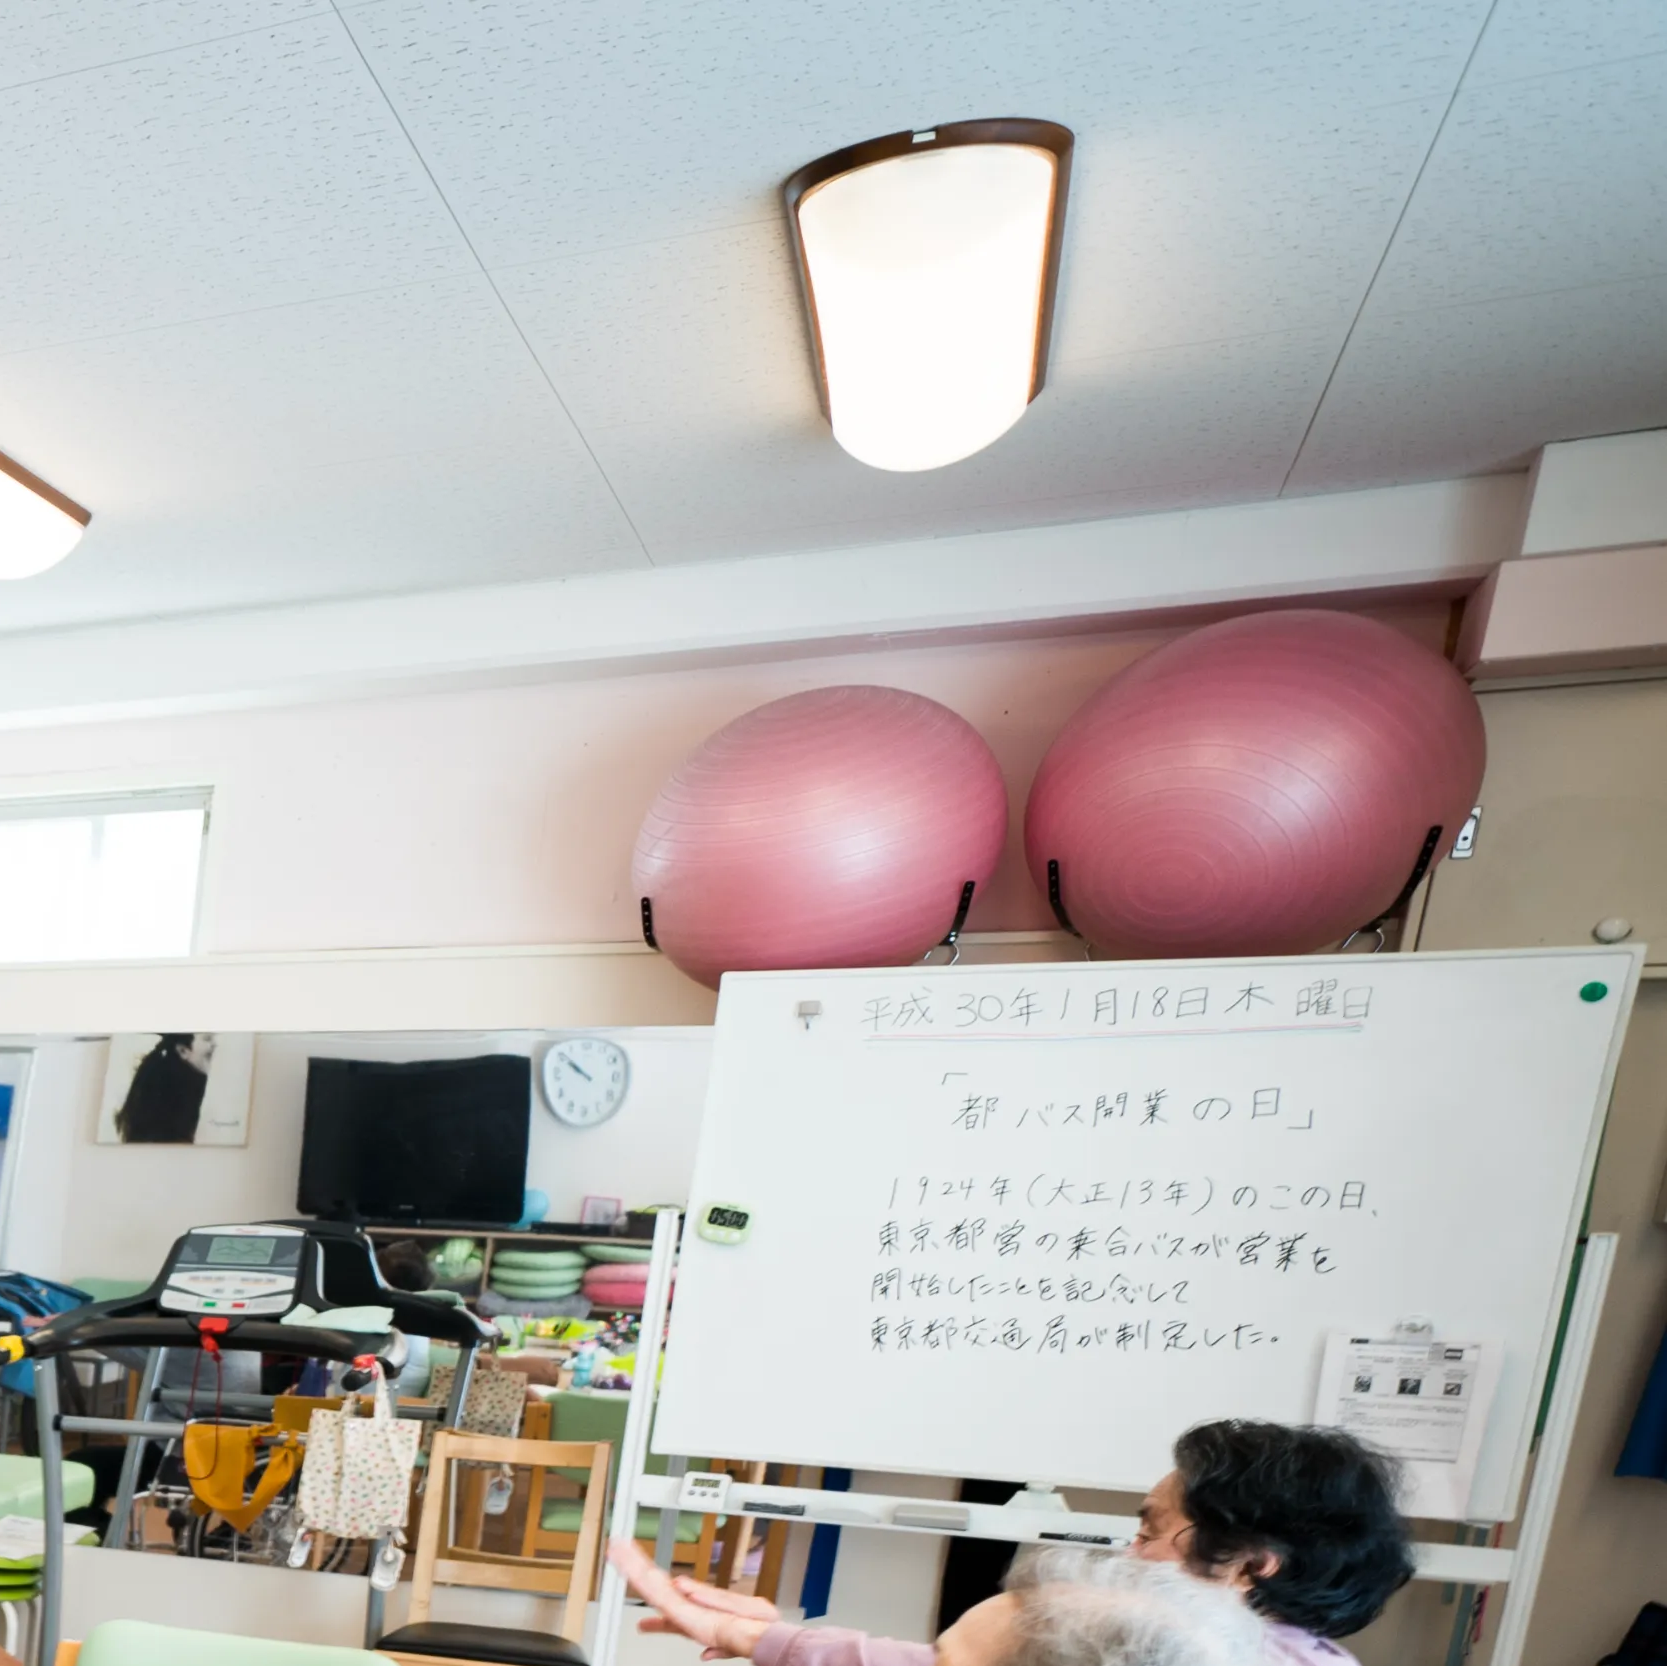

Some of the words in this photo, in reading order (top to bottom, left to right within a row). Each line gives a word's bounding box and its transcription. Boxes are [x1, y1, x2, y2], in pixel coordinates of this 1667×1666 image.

[878, 1217, 1337, 1274] 東京都営の乗合バスが営業を
[870, 1267, 1189, 1304] 開始したことを記念して
[870, 1315, 1280, 1354] 東京都交通局が制定した。
